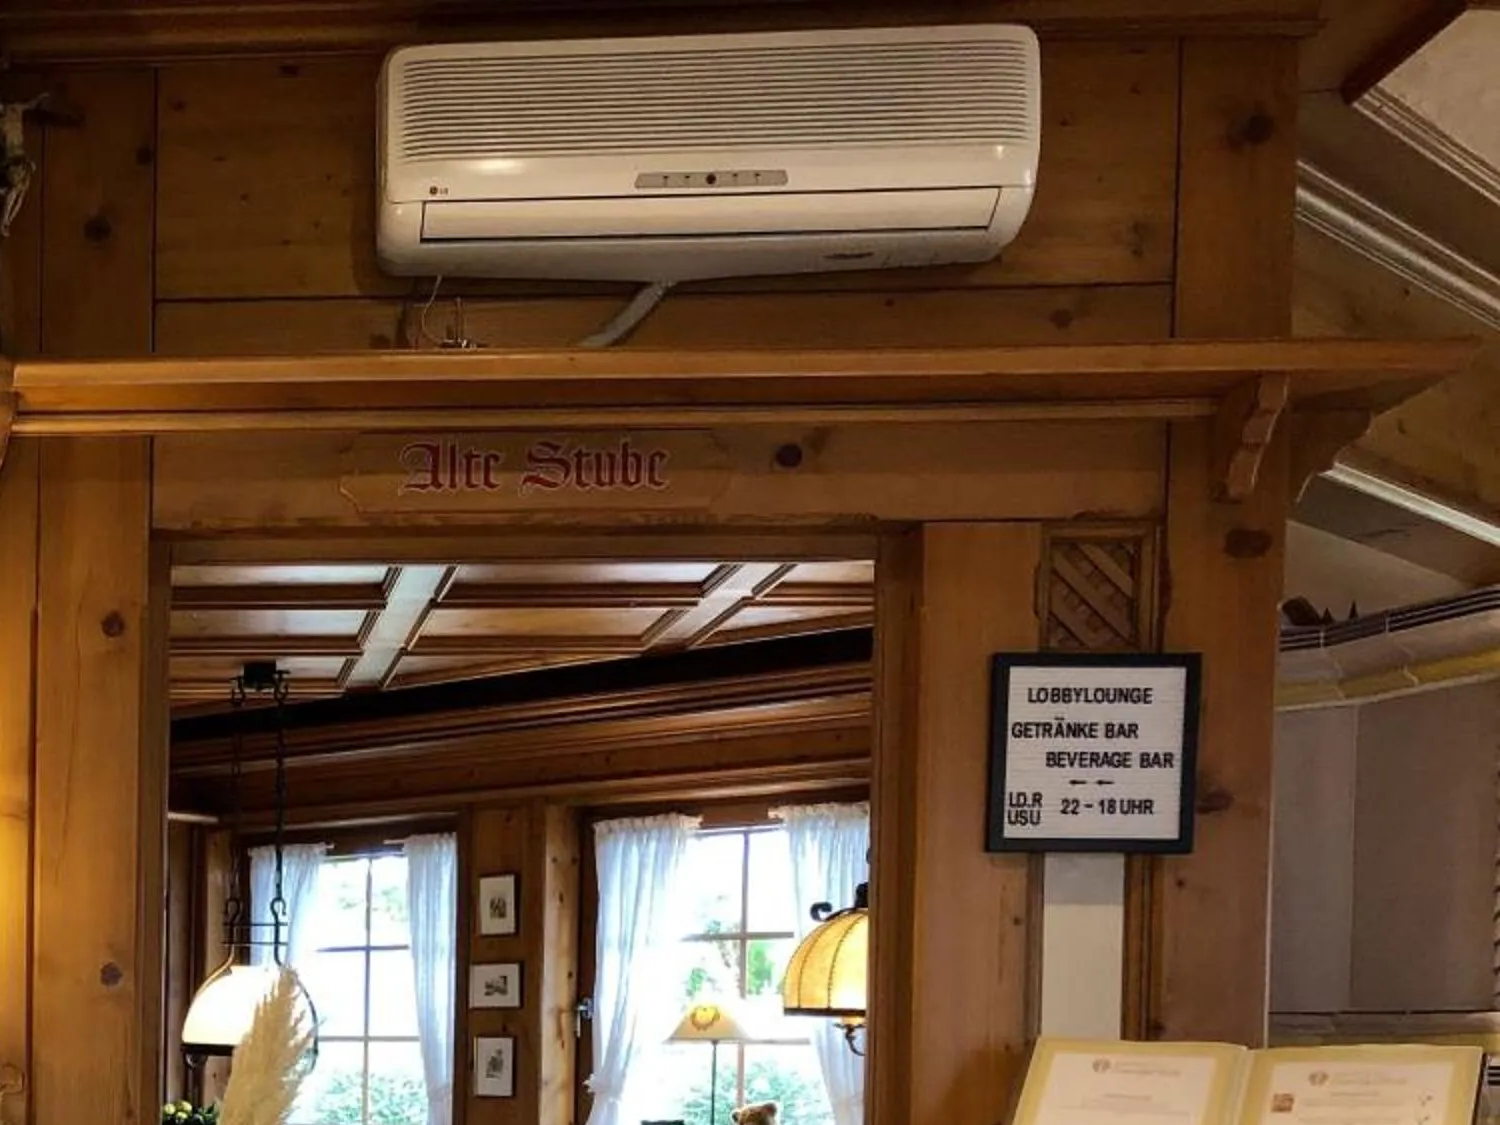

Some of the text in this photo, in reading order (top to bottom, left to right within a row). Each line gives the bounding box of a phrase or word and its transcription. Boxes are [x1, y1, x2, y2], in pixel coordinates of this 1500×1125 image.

[400, 438, 668, 492] Alte Stube
[1027, 687, 1154, 705] LOBBYLOUNGE
[1011, 716, 1140, 739] GETRÄNKE BAR
[1045, 751, 1175, 769] BEVERAGE BAR
[1059, 798, 1080, 815] 22
[1098, 798, 1117, 815] 18
[1119, 798, 1155, 816] UHR
[1008, 809, 1041, 826] USU
